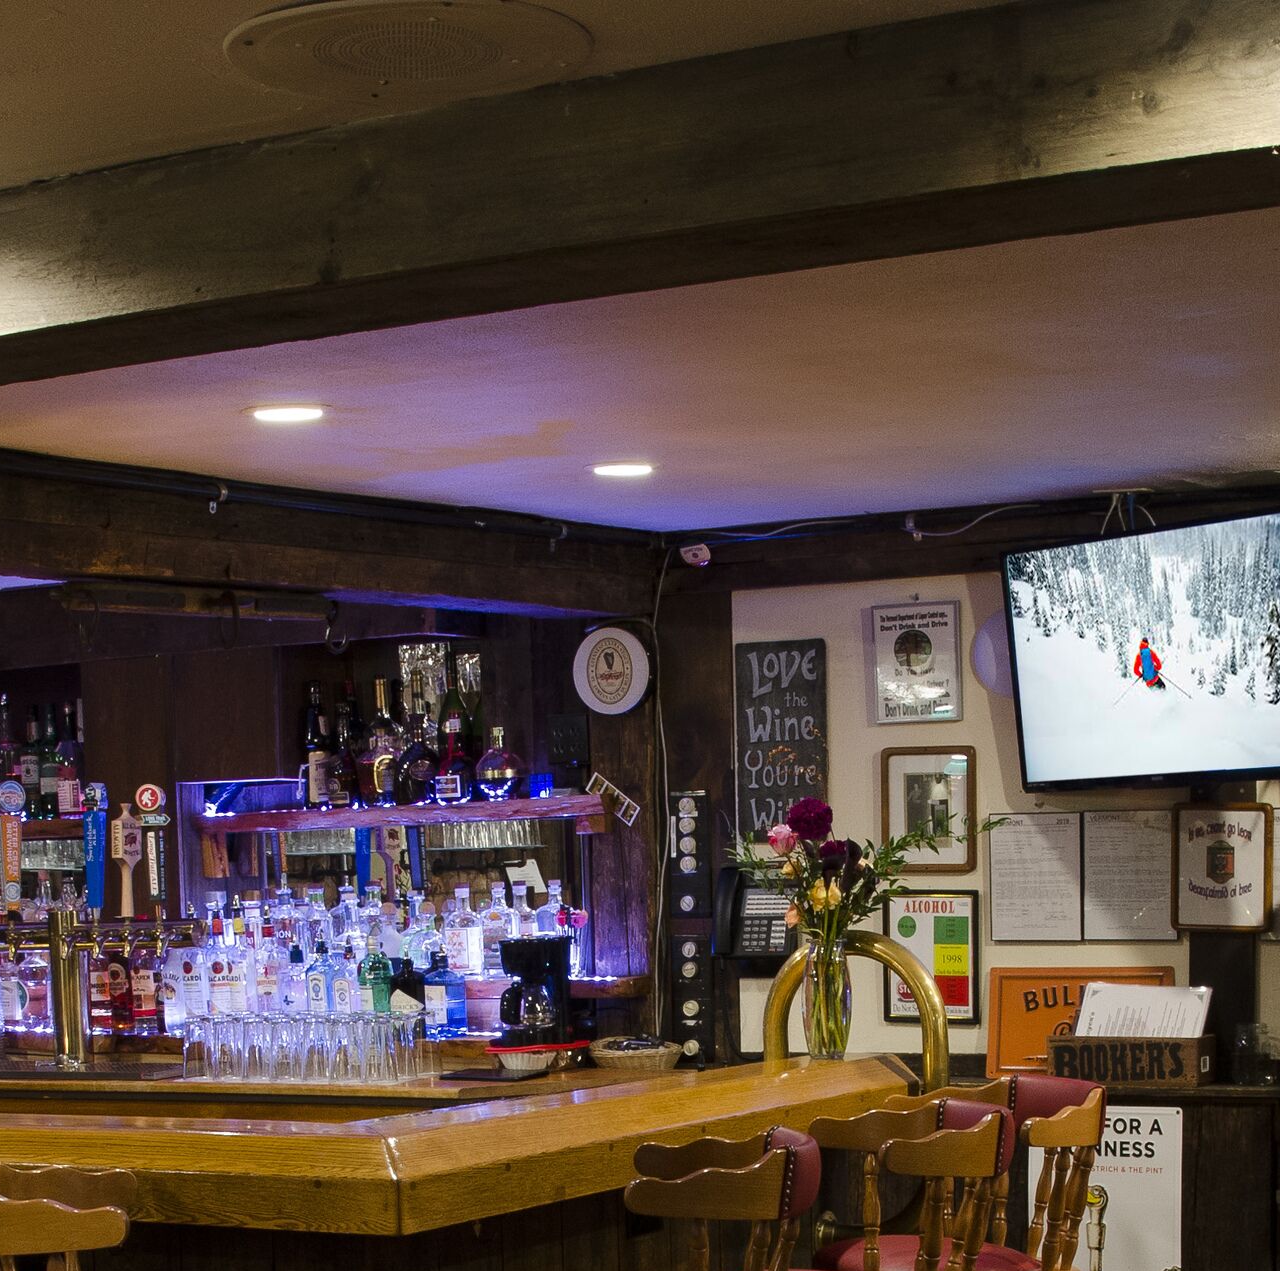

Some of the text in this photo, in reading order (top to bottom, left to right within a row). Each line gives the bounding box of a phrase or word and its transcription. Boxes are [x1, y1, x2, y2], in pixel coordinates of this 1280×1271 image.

[880, 620, 949, 632] Don't Drink and Drive
[747, 648, 817, 698] LOVE
[784, 691, 809, 707] the
[745, 705, 816, 744] Wine
[86, 813, 94, 862] Switchback
[904, 900, 955, 914] ALCOHOL
[942, 954, 962, 964] 1998
[899, 983, 912, 993] STO
[893, 1004, 902, 1013] Do
[902, 1004, 913, 1013] Not
[1053, 1040, 1185, 1081] BOOKER'S
[1148, 1118, 1163, 1136] A
[1096, 1140, 1156, 1159] NNESS
[1091, 1165, 1119, 1173] STRICH
[1145, 1166, 1163, 1174] PINT
